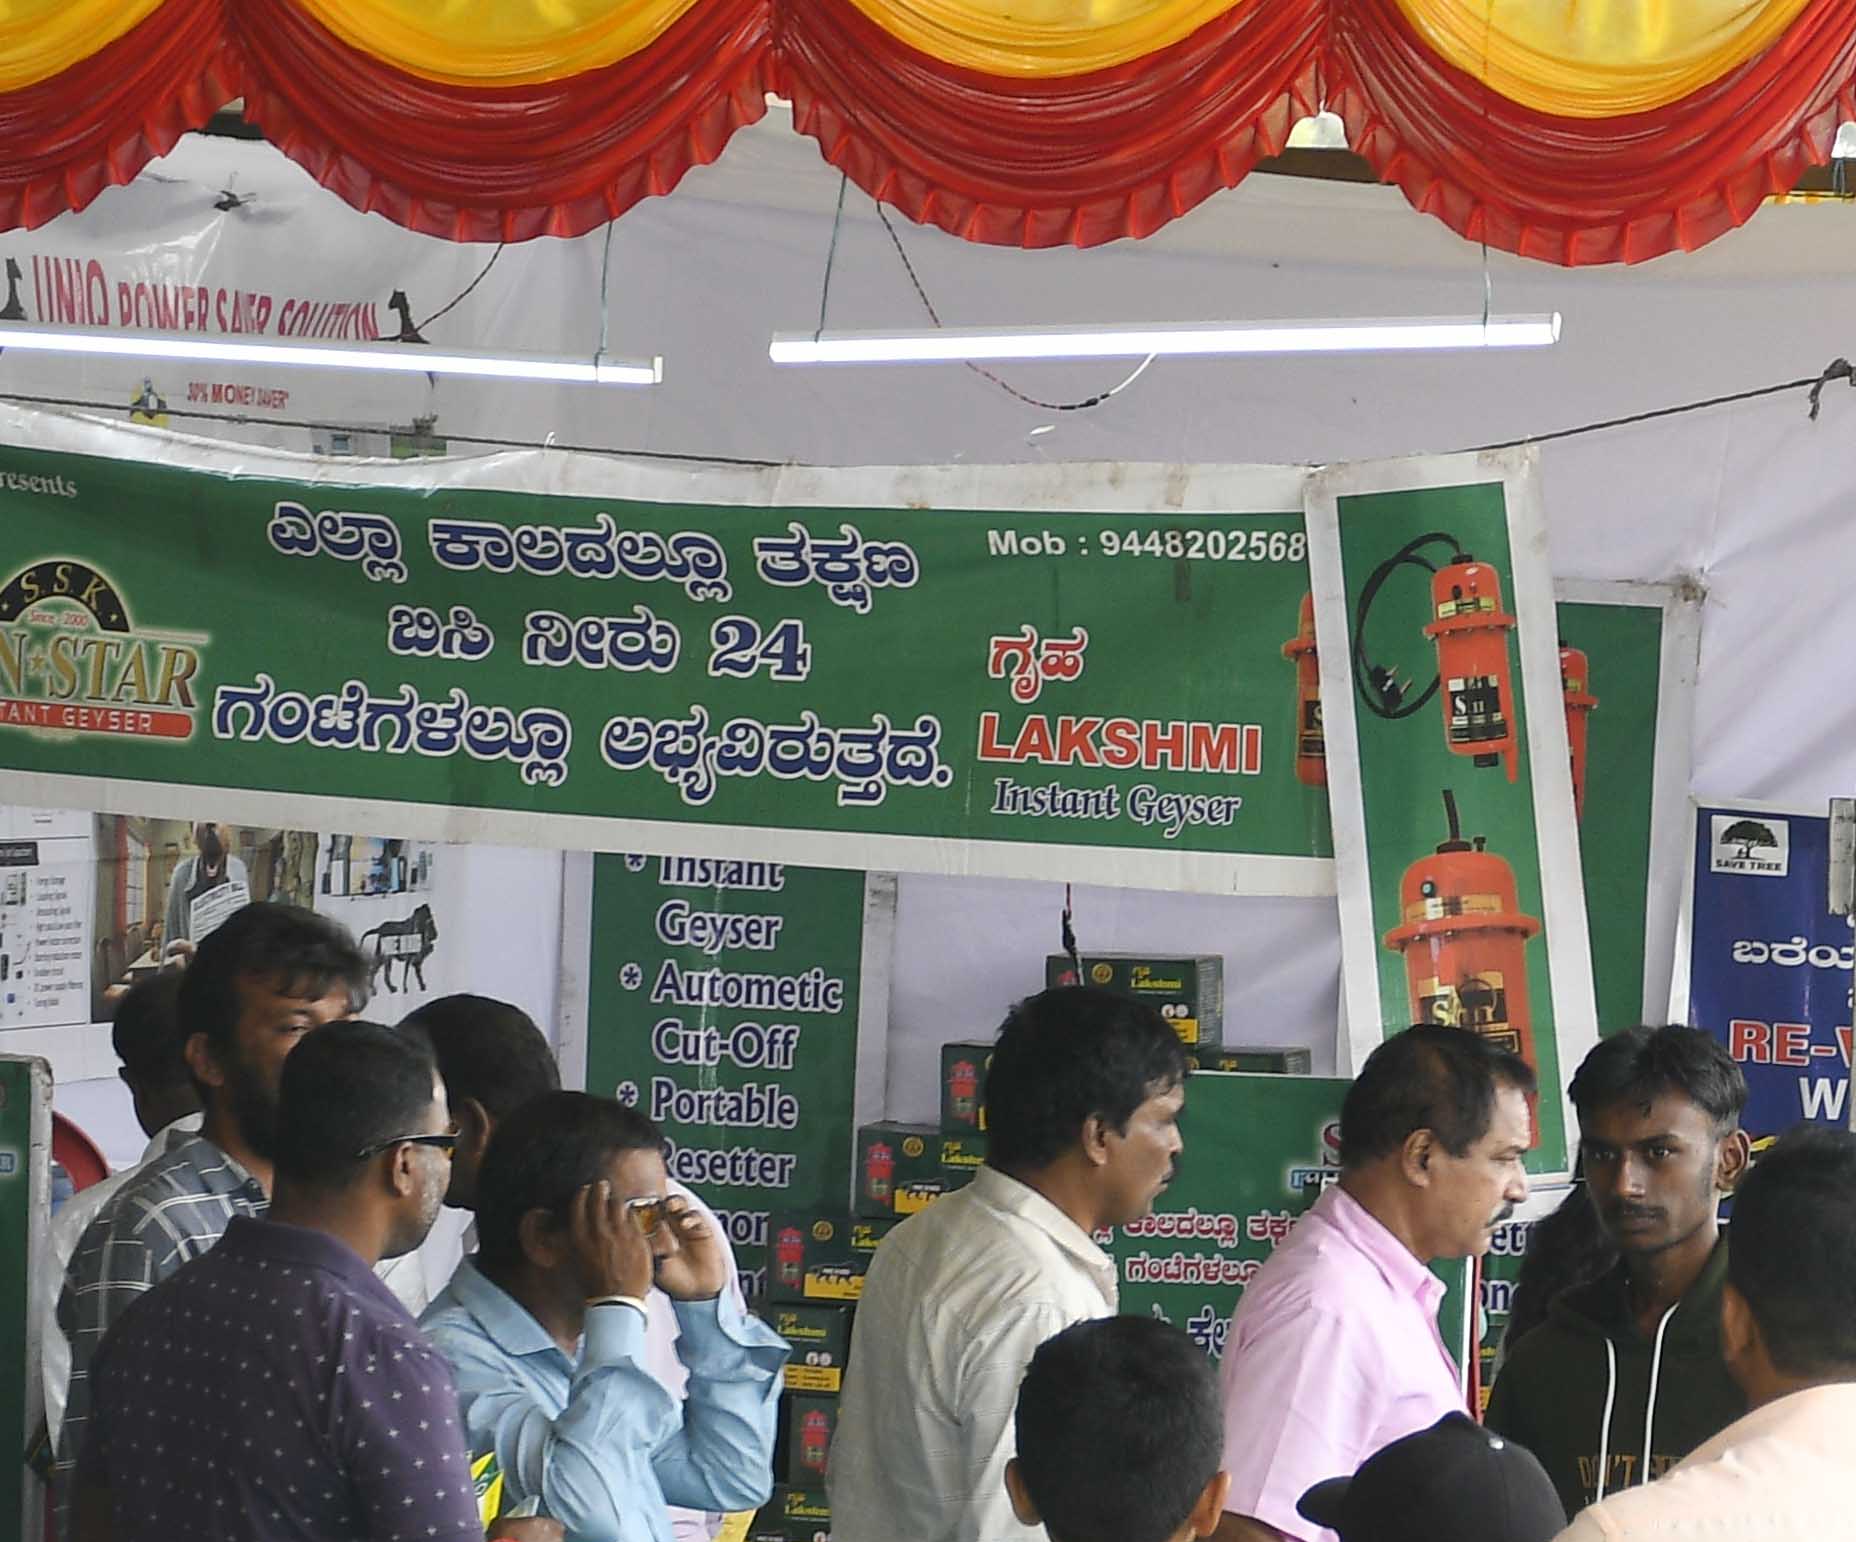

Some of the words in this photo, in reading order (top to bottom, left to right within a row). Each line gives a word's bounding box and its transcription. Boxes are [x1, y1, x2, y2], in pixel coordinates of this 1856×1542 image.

[211, 383, 254, 407] MONEY
[0, 471, 78, 498] resents
[428, 512, 732, 602] ಕಾಲದಲ್ಲೂ
[754, 522, 920, 614] ತಕ್ಷಣ
[988, 530, 1066, 556] Mob
[1100, 530, 1306, 562] 9448202568
[389, 604, 494, 661] ಬಿಸಿ
[524, 604, 681, 673] ನೀರು
[709, 616, 811, 681] 24
[988, 623, 1089, 703] ಗೃಹ
[62, 706, 153, 732] GEYSER
[212, 673, 573, 787] ಗಂಟೆಗಳಲ್ಲೂ
[977, 713, 1264, 776] LAKSHMI
[991, 777, 1121, 822] Instant
[1127, 784, 1242, 838] Geyser
[658, 854, 784, 890] Instant
[1716, 859, 1746, 870] SAVE
[1749, 861, 1782, 872] TREE
[656, 899, 783, 955] Geyser
[650, 958, 845, 1014] Autometic
[652, 1017, 800, 1070] Cut-Off
[651, 1076, 799, 1129] Portable
